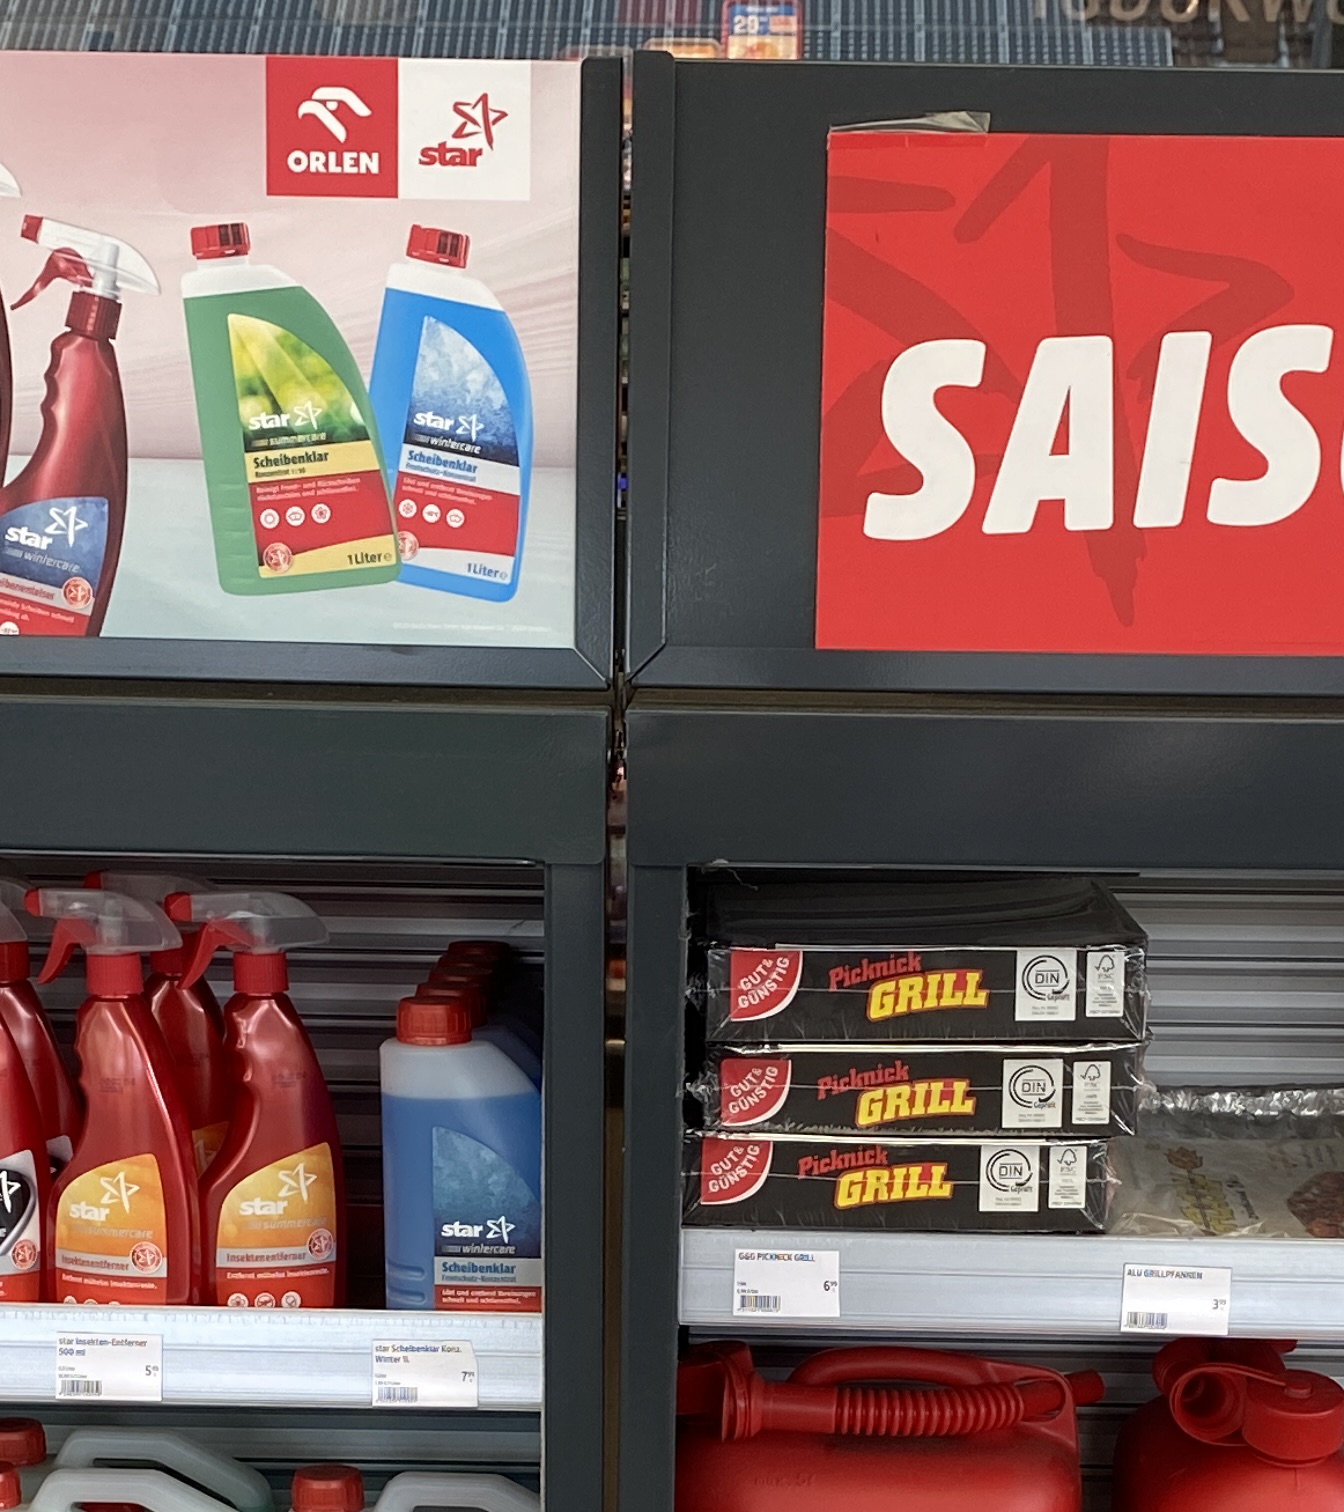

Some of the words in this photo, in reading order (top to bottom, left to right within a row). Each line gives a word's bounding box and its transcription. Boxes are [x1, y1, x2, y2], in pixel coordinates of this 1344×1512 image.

[287, 150, 380, 175] ORLEN
[419, 142, 483, 167] star
[249, 412, 290, 431] star
[413, 411, 453, 431] star
[430, 438, 481, 455] wintercare
[253, 451, 329, 468] Scheibenklar
[407, 450, 478, 474] Scheibenklar
[5, 526, 52, 550] star
[355, 551, 382, 565] Liter
[473, 562, 500, 578] Liter
[739, 958, 774, 992] GUT&
[828, 950, 922, 992] Picknick
[1035, 971, 1060, 986] DIN
[737, 956, 790, 1010] GÜNSTIG
[868, 969, 990, 1021] GRILL
[730, 1067, 763, 1097] GUT&
[817, 1060, 910, 1100] Picknick
[1022, 1079, 1047, 1095] DIN
[728, 1066, 779, 1115] GÜNSTIG
[857, 1078, 976, 1128] GRILL
[709, 1144, 761, 1193] GÜNSTIG
[711, 1146, 744, 1176] GUT&
[798, 1145, 889, 1179] Picknick
[999, 1163, 1024, 1179] DIN
[834, 1162, 953, 1210] GRILL
[69, 1202, 109, 1221] star
[239, 1197, 289, 1217] star
[441, 1220, 483, 1238] star
[462, 1243, 516, 1255] wintercare
[757, 1252, 793, 1261] PICKNICK
[442, 1261, 516, 1275] Scheibenklar
[1127, 1268, 1142, 1277] ALU
[58, 1348, 74, 1356] 500
[375, 1354, 401, 1364] Winter
